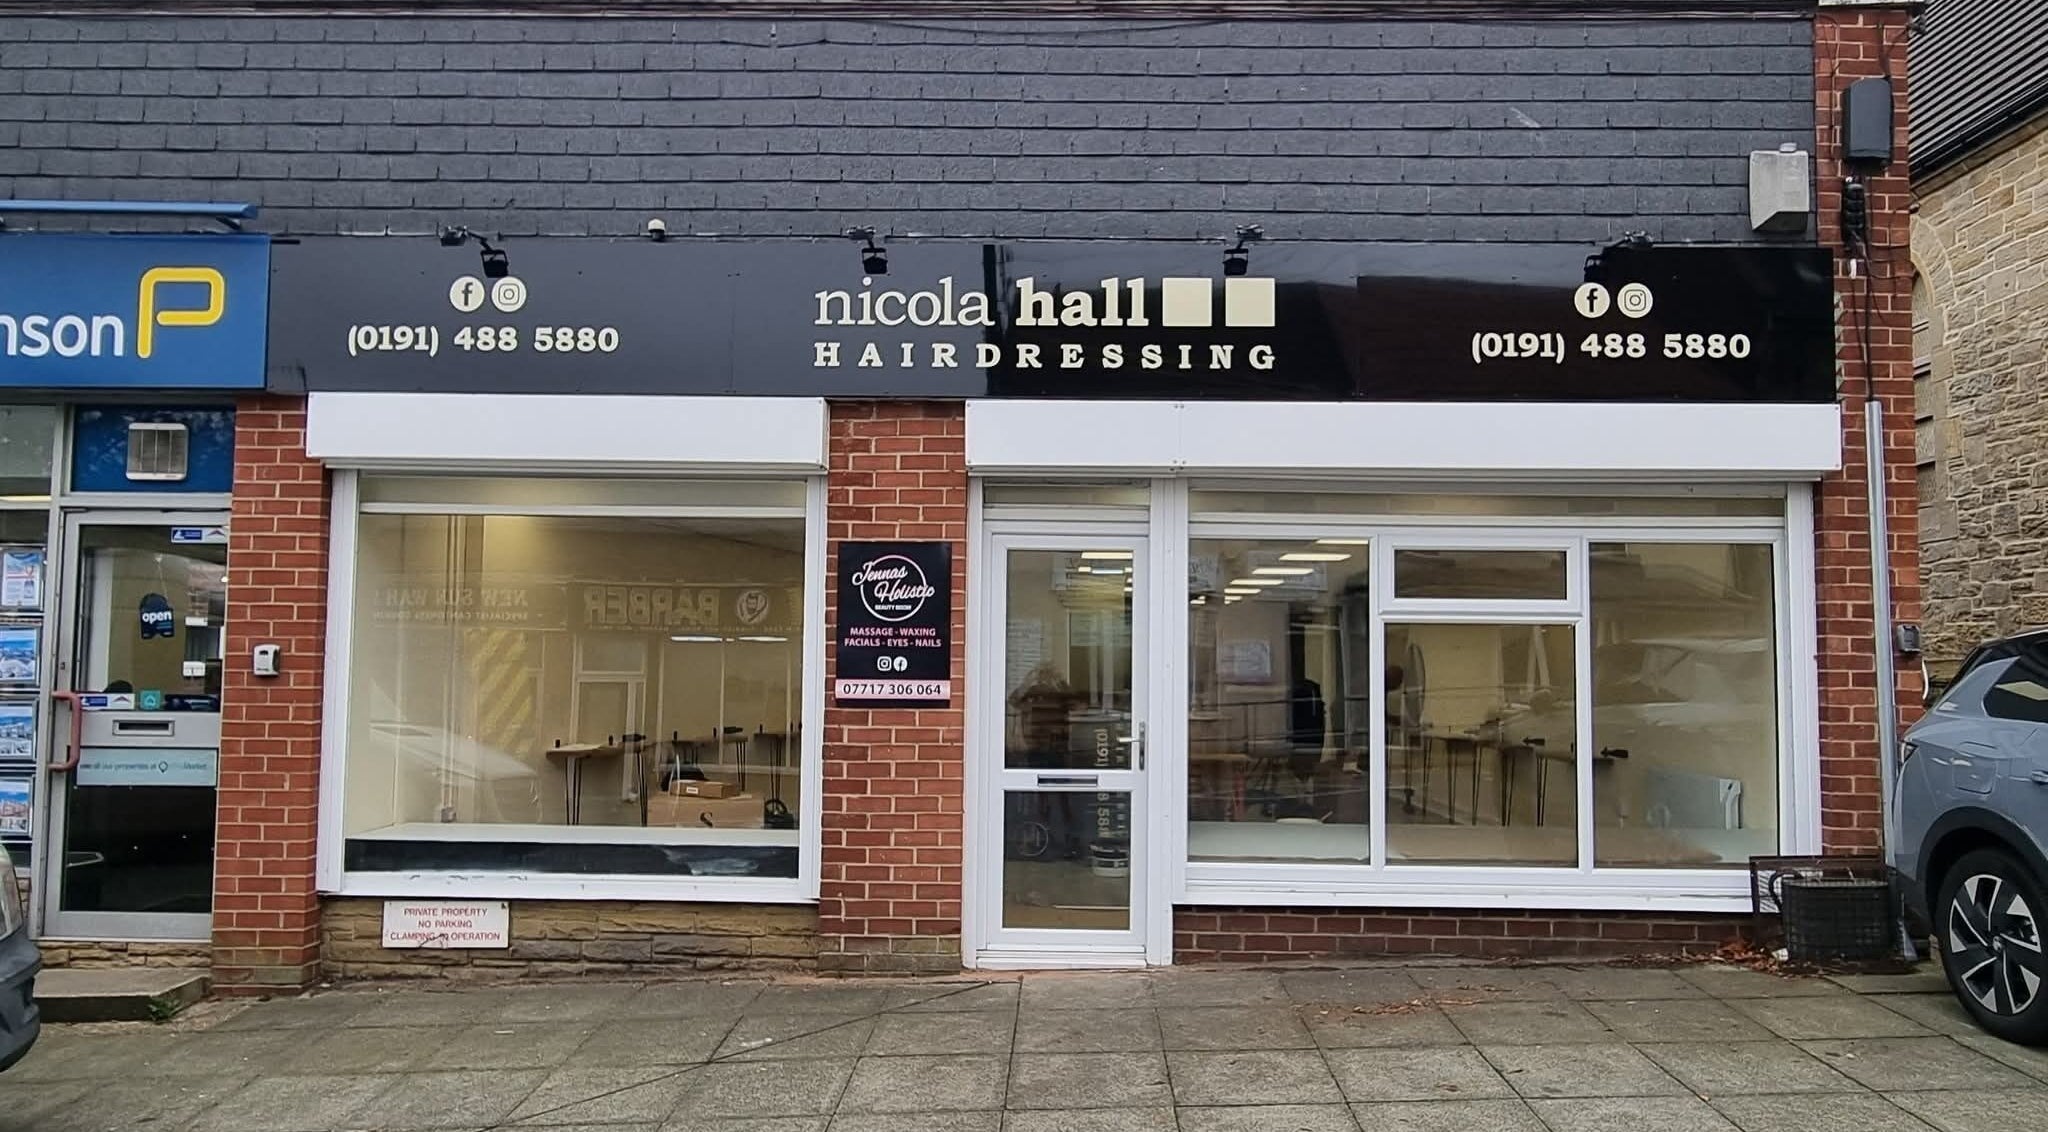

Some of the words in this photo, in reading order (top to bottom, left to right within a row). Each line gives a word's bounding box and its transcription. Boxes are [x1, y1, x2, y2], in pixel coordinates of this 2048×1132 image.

[814, 276, 995, 327] nicola
[1015, 276, 1150, 327] hall
[348, 325, 439, 357] (0191)
[454, 326, 518, 352] 488
[534, 327, 619, 352] 5880
[1471, 332, 1565, 364] (0191)
[1580, 333, 1647, 358] 488
[1663, 333, 1751, 359] 5880
[813, 341, 1275, 371] HAIRDRESSING
[852, 561, 908, 586] Jennas
[142, 611, 172, 625] open
[850, 627, 893, 637] MASSAGE
[900, 627, 936, 637] WAXING
[844, 638, 880, 647] FACIALS
[887, 638, 909, 647] EYES
[915, 639, 942, 648] NAILS
[843, 684, 885, 695] 07717
[888, 684, 913, 695] 306
[916, 684, 942, 695] 064
[403, 908, 438, 916] PRIVATE
[441, 908, 488, 916] PROPERTY
[418, 920, 431, 928] NO
[435, 920, 473, 928] PARKING
[390, 932, 435, 941] CLAMPING
[450, 932, 501, 940] OPERATION
